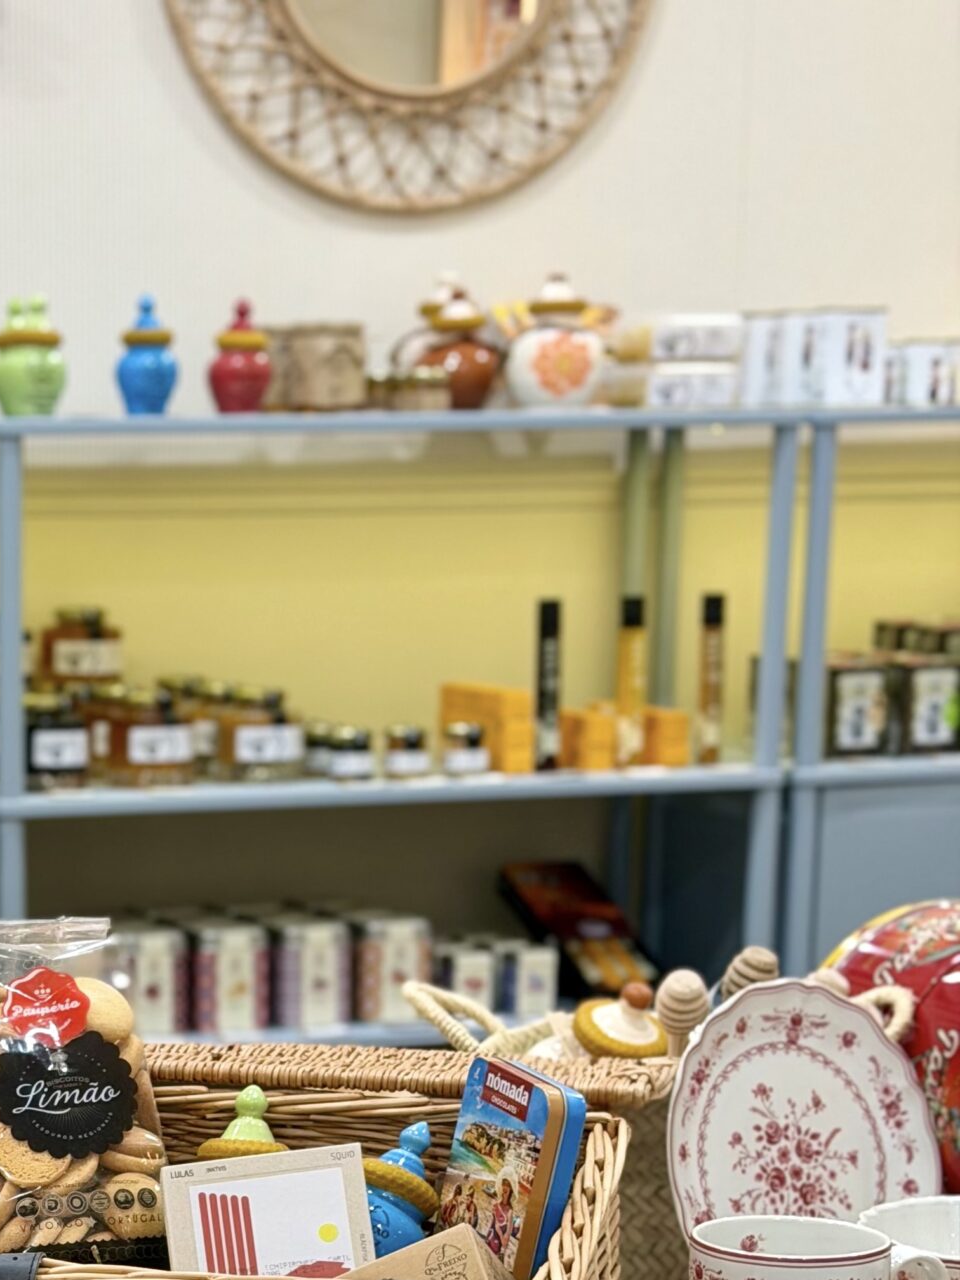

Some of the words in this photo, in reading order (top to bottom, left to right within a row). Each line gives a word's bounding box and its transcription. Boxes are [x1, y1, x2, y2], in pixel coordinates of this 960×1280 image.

[12, 999, 81, 1017] Paupério
[485, 1072, 529, 1106] nómada
[12, 1080, 120, 1114] Limão
[330, 1151, 355, 1162] SQUID
[170, 1169, 194, 1179] LULAS
[100, 1213, 161, 1226] ORTUGAL
